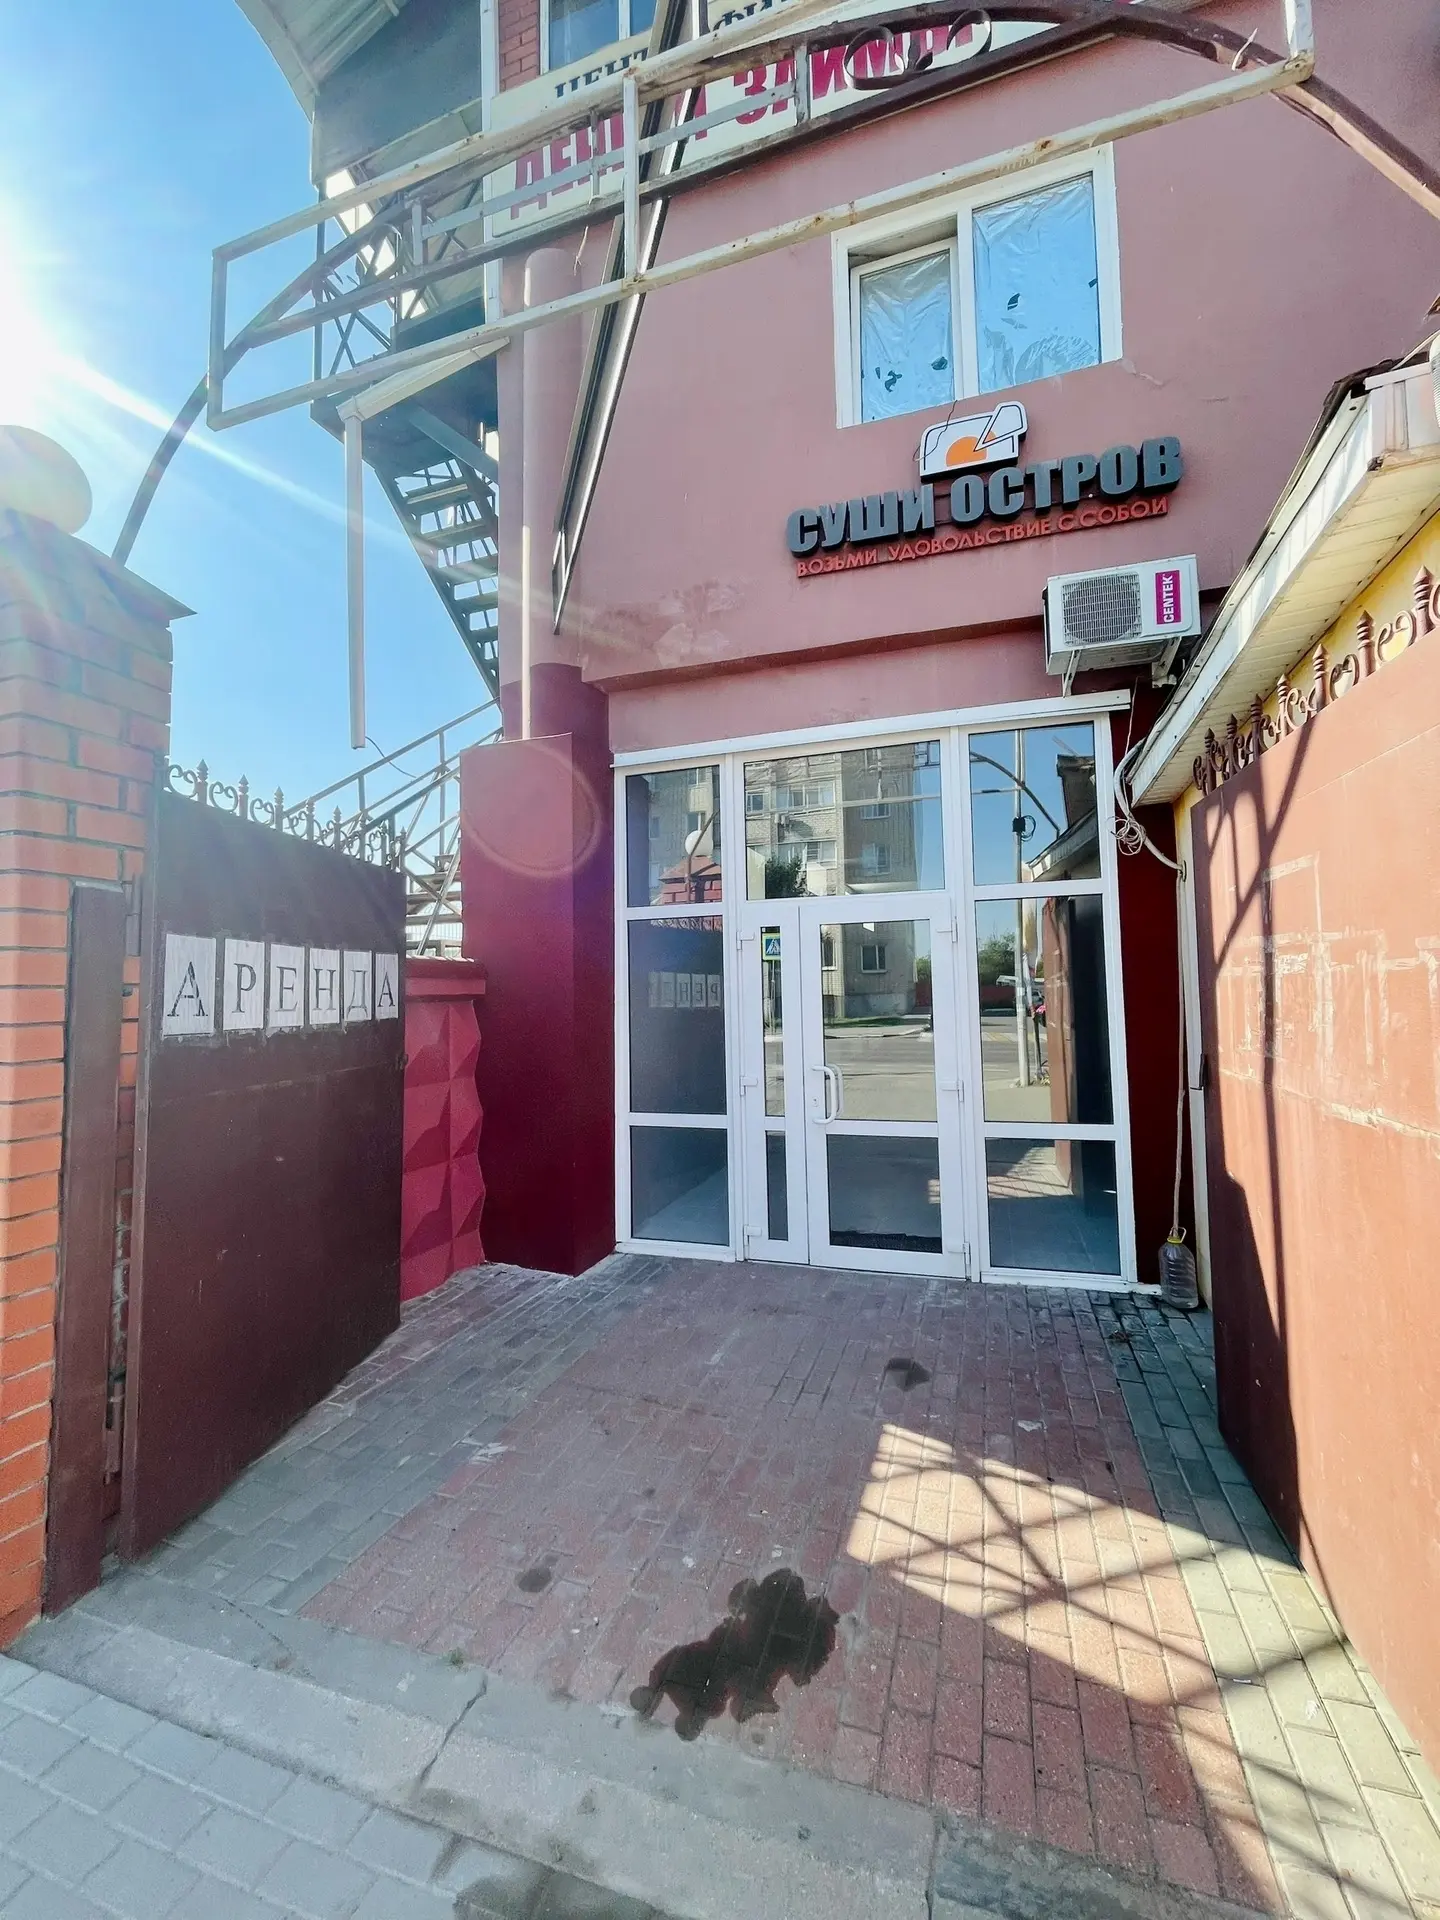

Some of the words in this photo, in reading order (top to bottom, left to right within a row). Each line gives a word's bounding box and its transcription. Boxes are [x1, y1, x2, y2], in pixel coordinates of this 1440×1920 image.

[787, 483, 936, 556] СУШИ
[950, 436, 1184, 524] ОСТРОВ
[797, 548, 878, 577] ВОЗЬМИ
[888, 519, 1052, 561] УДОВОЛЬСТВИЕ
[1058, 513, 1075, 532] С
[1079, 496, 1169, 528] СОБОЙ
[1162, 574, 1175, 623] CENTEK
[166, 960, 396, 1020] АРЕНДА
